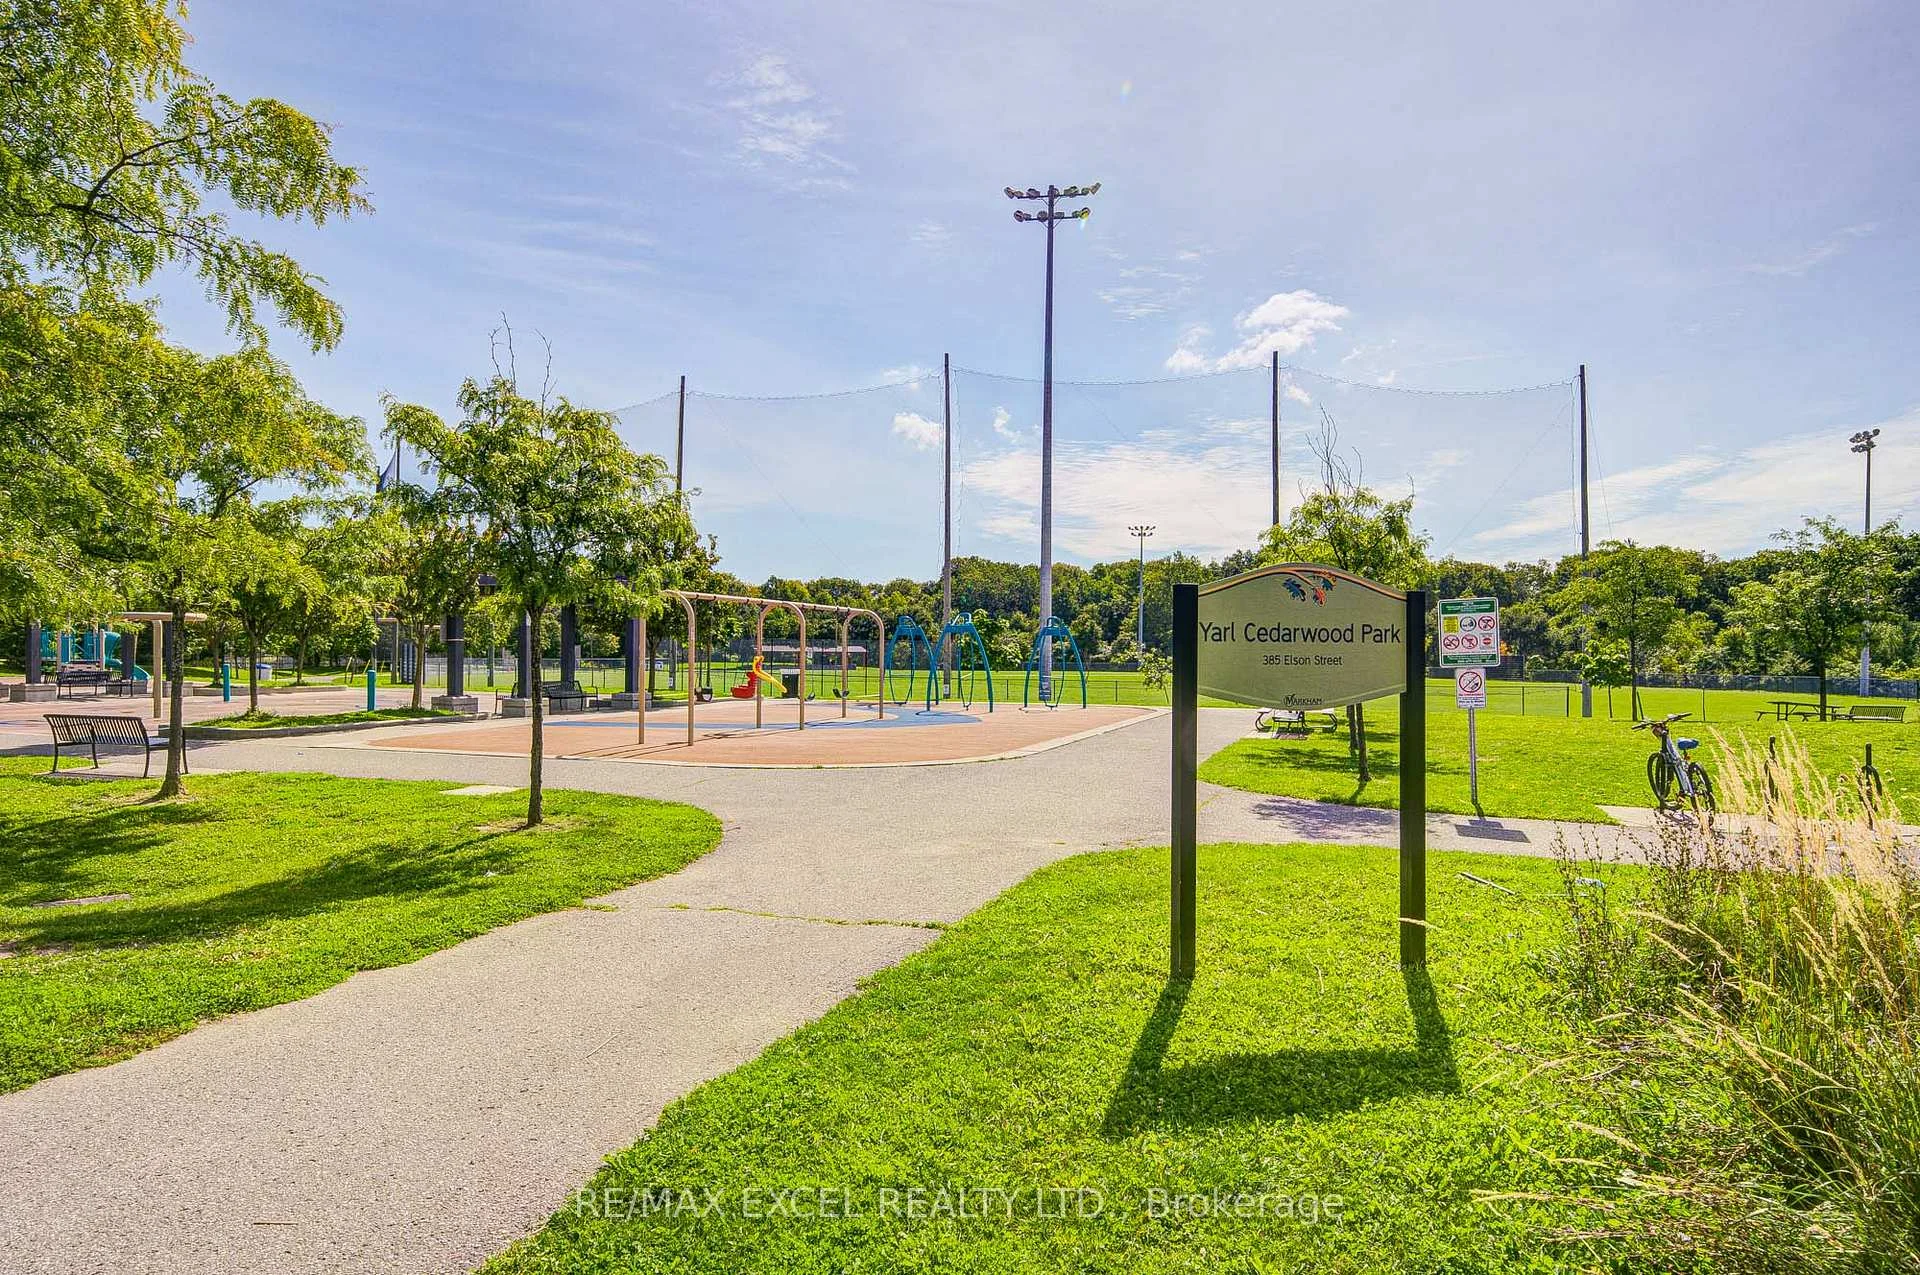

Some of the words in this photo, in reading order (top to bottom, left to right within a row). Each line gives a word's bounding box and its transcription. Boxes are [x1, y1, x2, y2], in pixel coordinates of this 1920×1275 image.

[1200, 621, 1236, 643] Yarl
[1244, 622, 1354, 643] Cedarwood
[1361, 623, 1401, 643] Park
[1262, 655, 1280, 666] 385
[1284, 655, 1311, 666] Elson
[1314, 655, 1343, 666] Street
